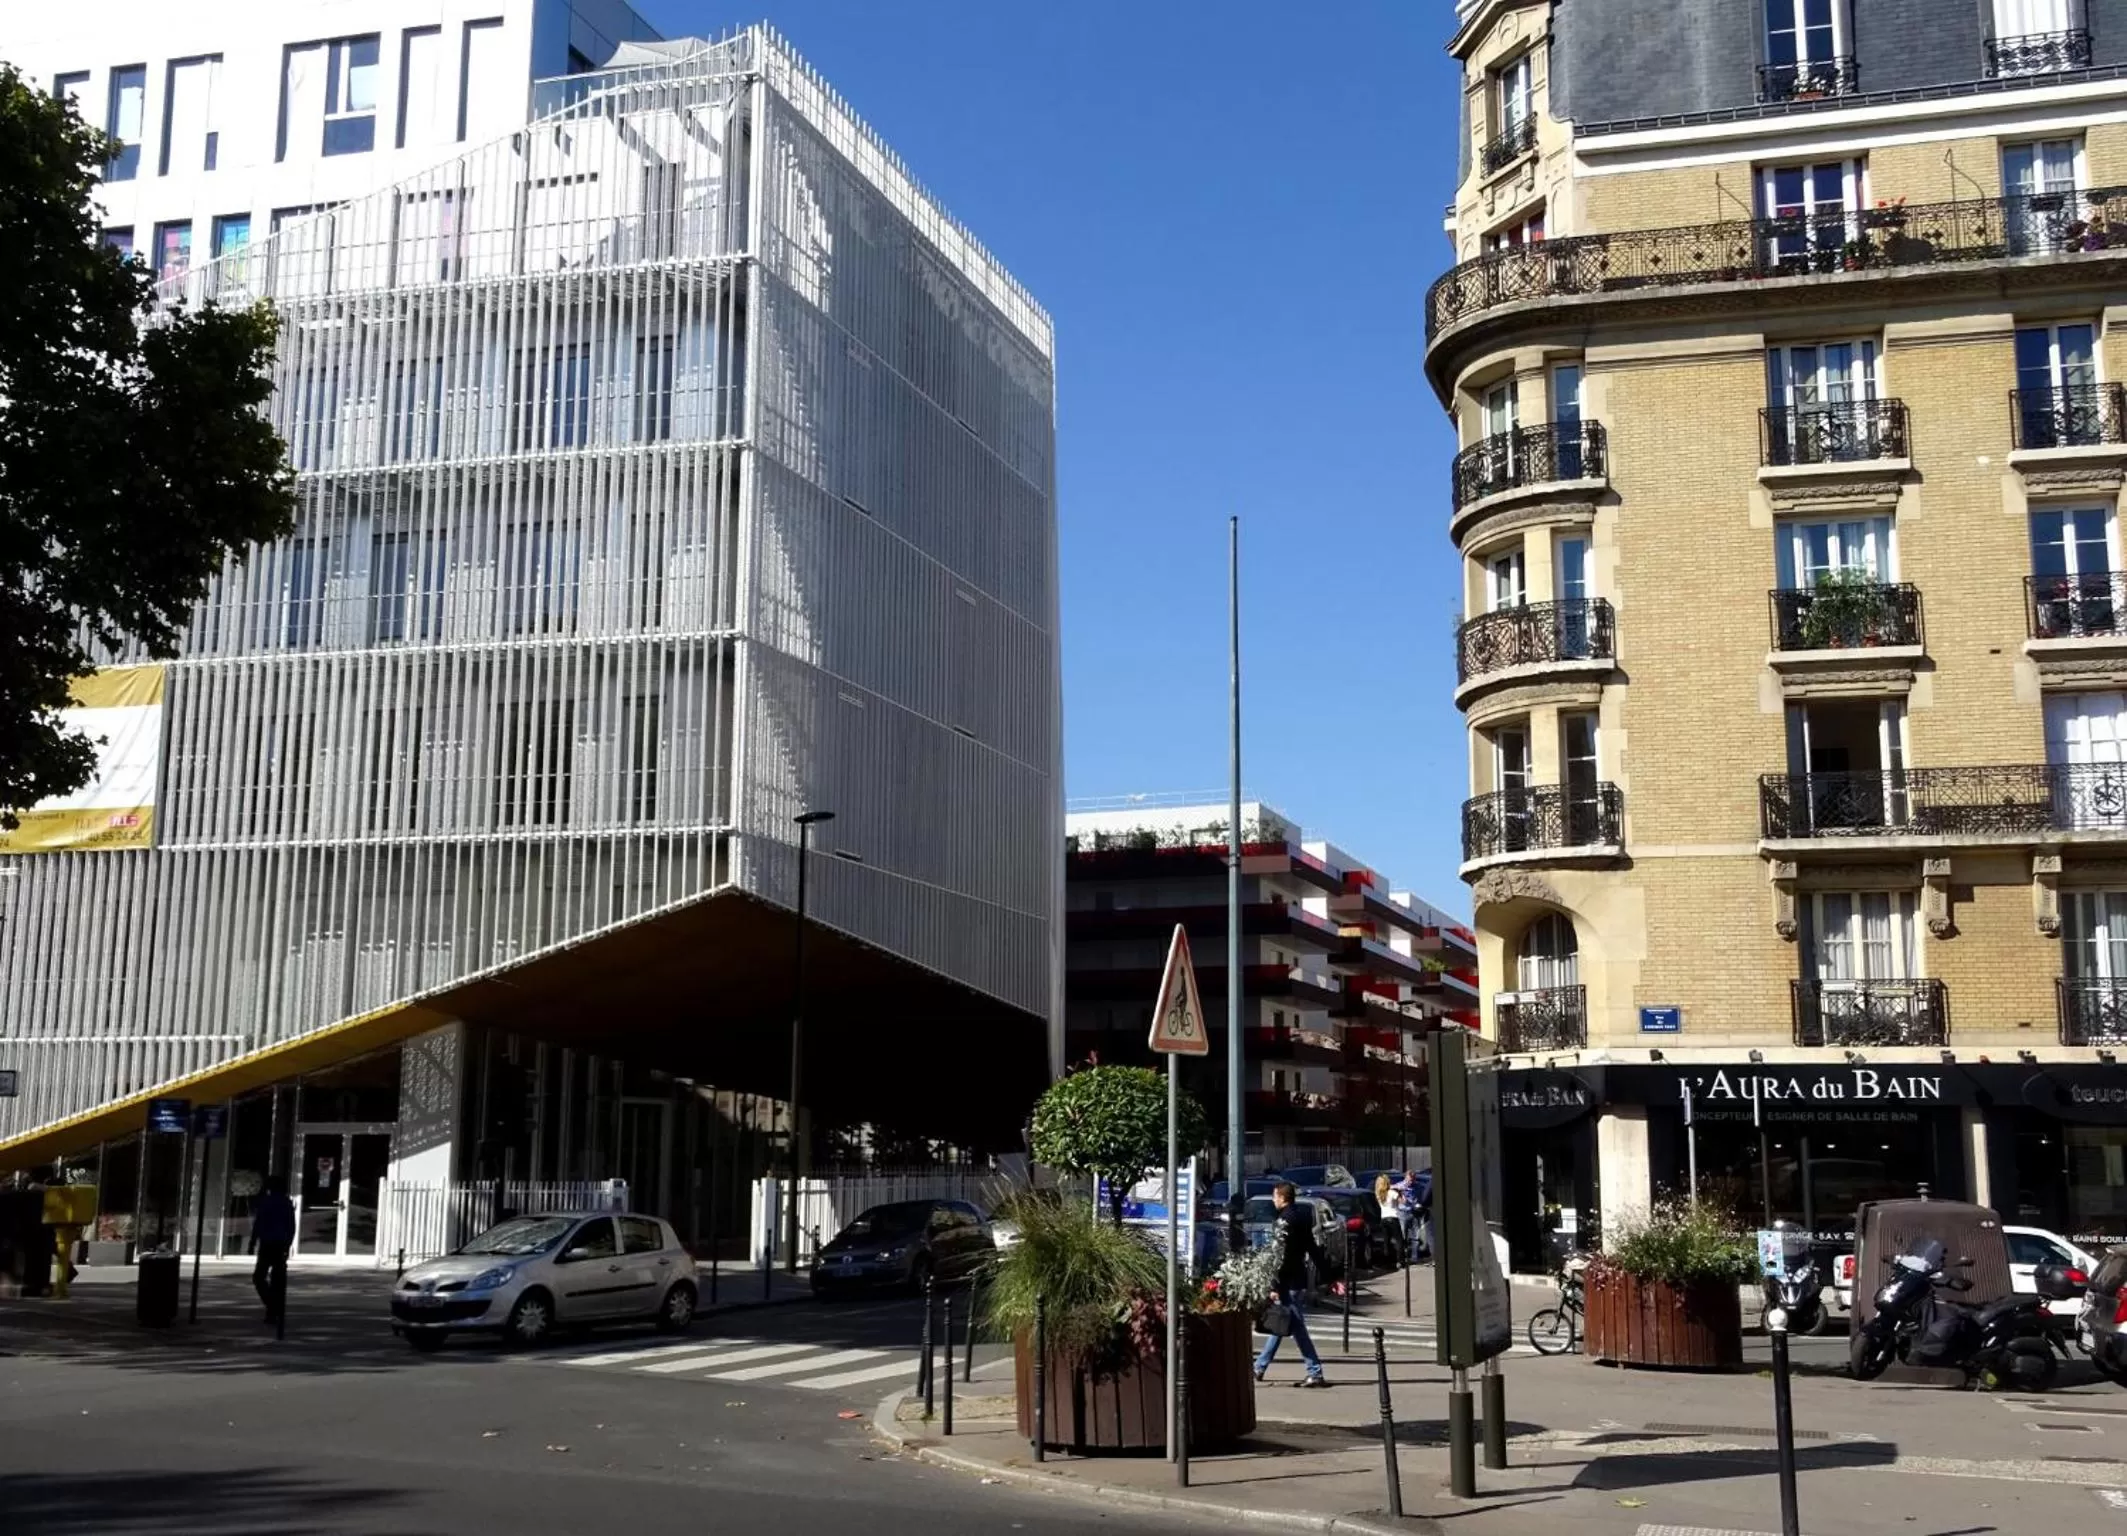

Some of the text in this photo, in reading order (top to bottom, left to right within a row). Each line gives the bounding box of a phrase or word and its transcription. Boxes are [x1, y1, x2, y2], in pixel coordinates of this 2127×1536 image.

[1812, 1077, 1845, 1099] du
[1851, 1069, 1941, 1099] BAIN
[2072, 1084, 2127, 1103] teuc
